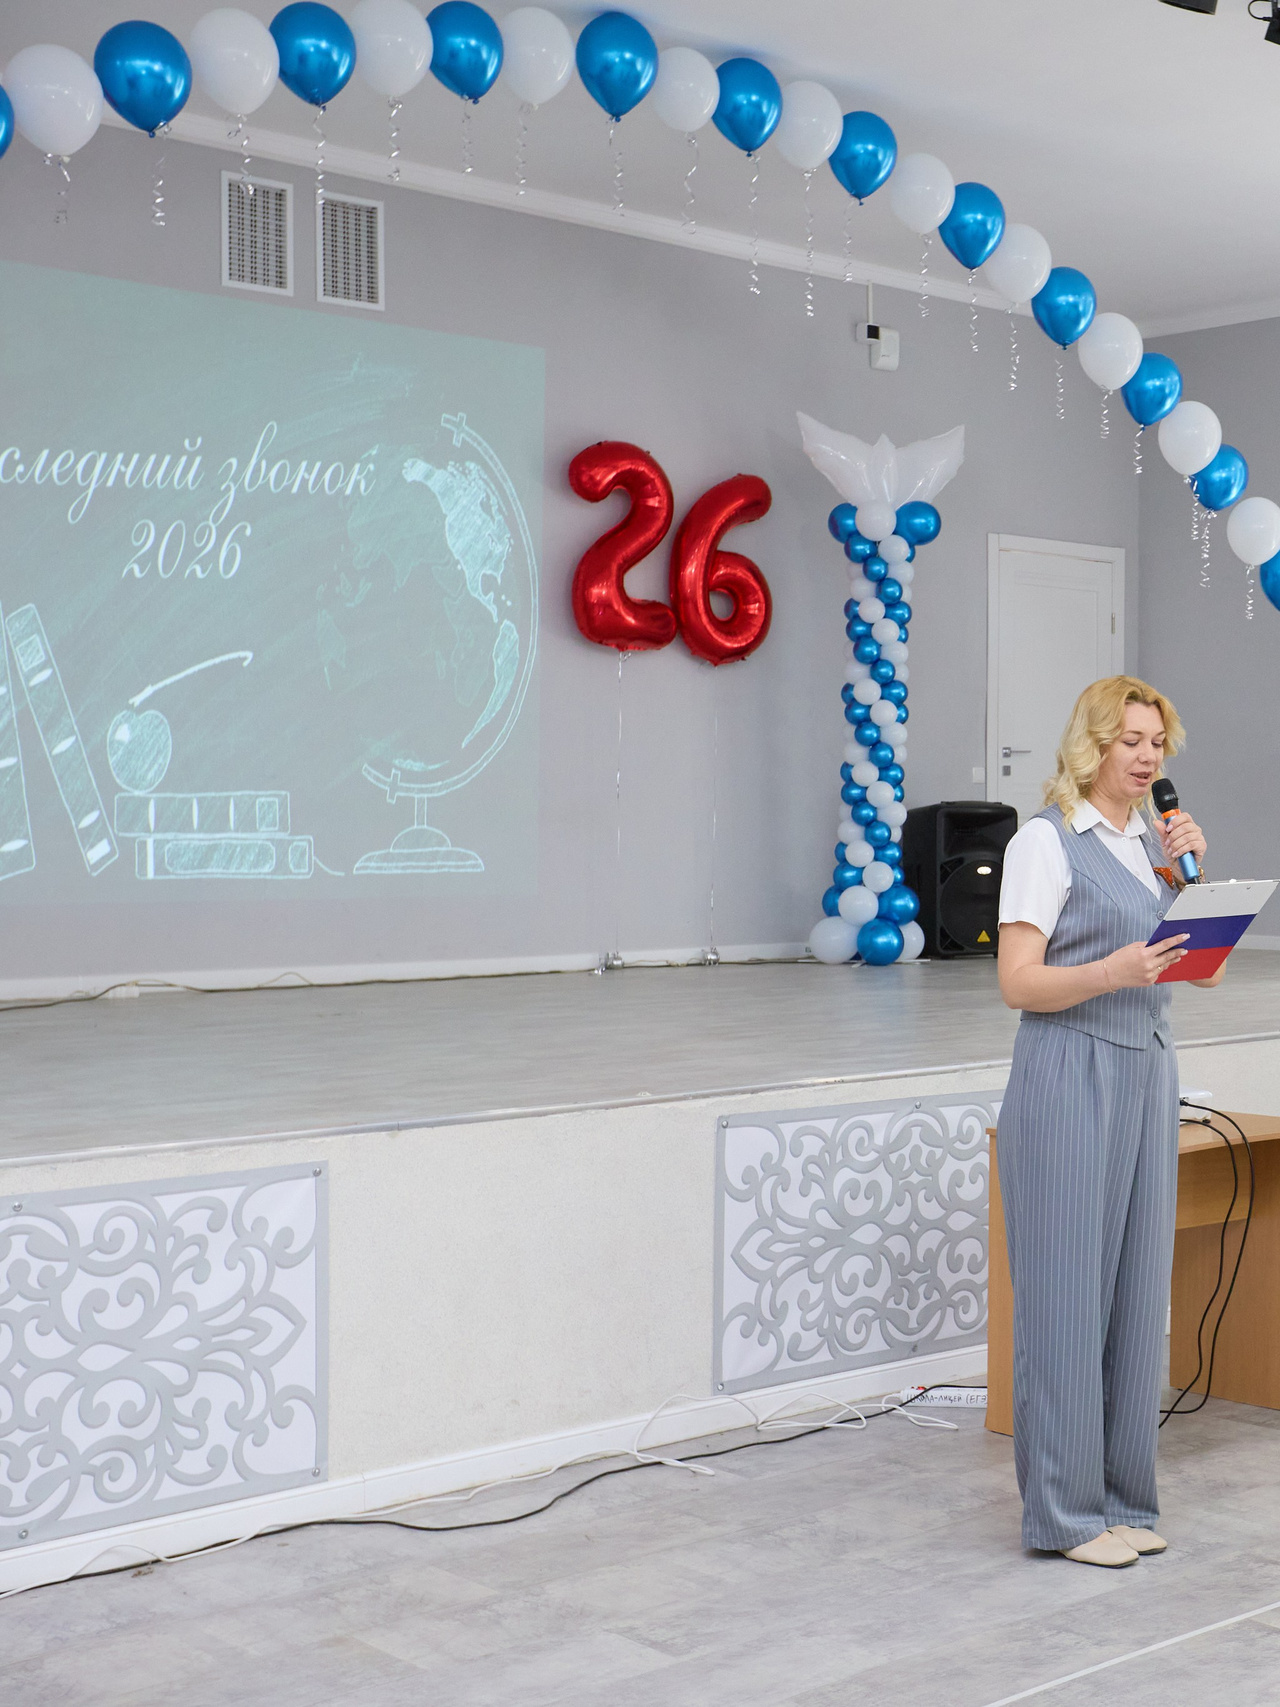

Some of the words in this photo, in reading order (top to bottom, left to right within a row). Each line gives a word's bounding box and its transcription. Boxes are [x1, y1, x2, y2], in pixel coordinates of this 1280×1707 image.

[0, 436, 204, 524] следний
[217, 421, 376, 526] звонок
[121, 519, 251, 579] 2026
[568, 440, 772, 666] 26
